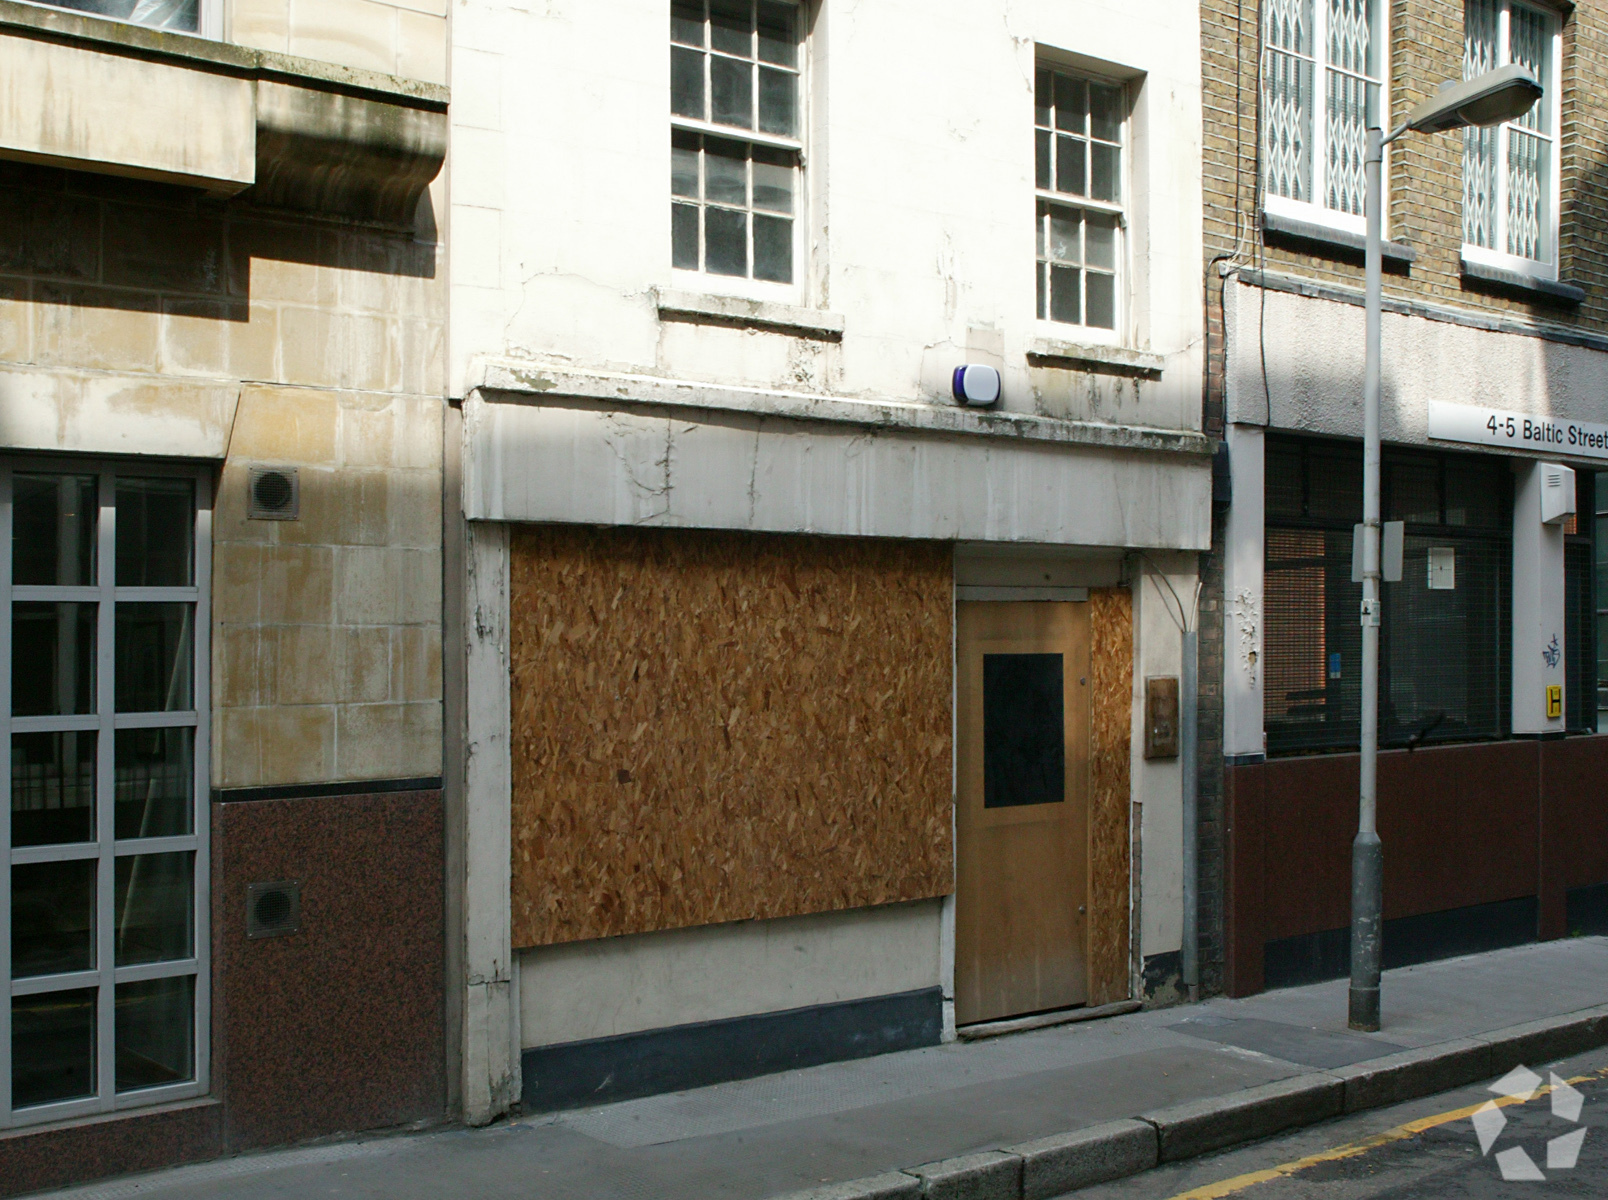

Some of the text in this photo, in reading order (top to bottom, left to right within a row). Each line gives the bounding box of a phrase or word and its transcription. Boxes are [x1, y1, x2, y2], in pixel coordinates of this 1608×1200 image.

[1486, 415, 1608, 449] 4-5 Baltic Street
[1550, 688, 1561, 714] H
